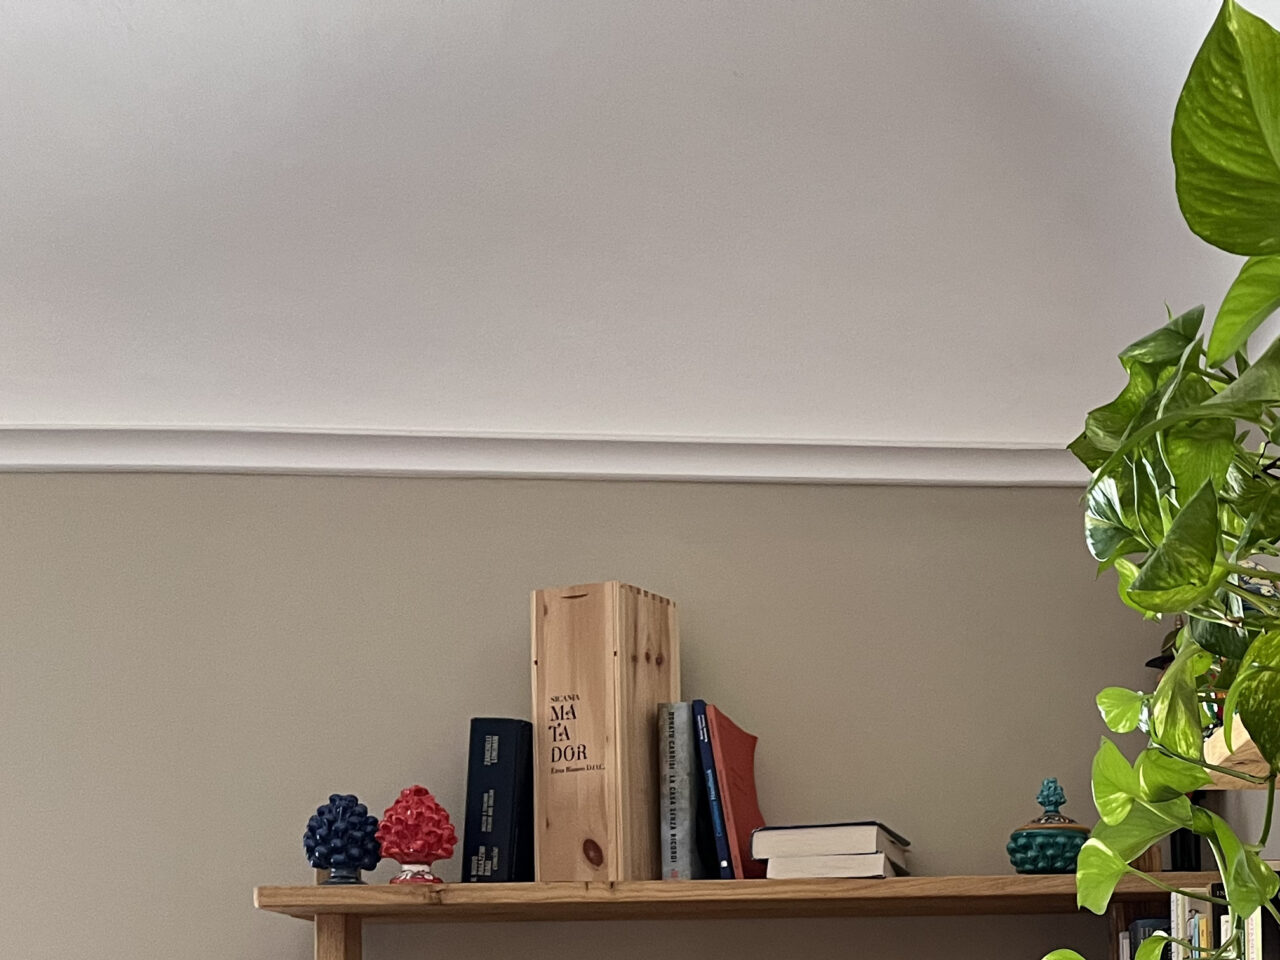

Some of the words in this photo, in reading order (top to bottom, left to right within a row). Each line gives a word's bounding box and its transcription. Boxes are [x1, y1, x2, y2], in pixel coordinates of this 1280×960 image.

[550, 704, 577, 722] MA
[548, 722, 570, 742] TA
[551, 744, 587, 763] DOR
[669, 808, 677, 831] SENZA
